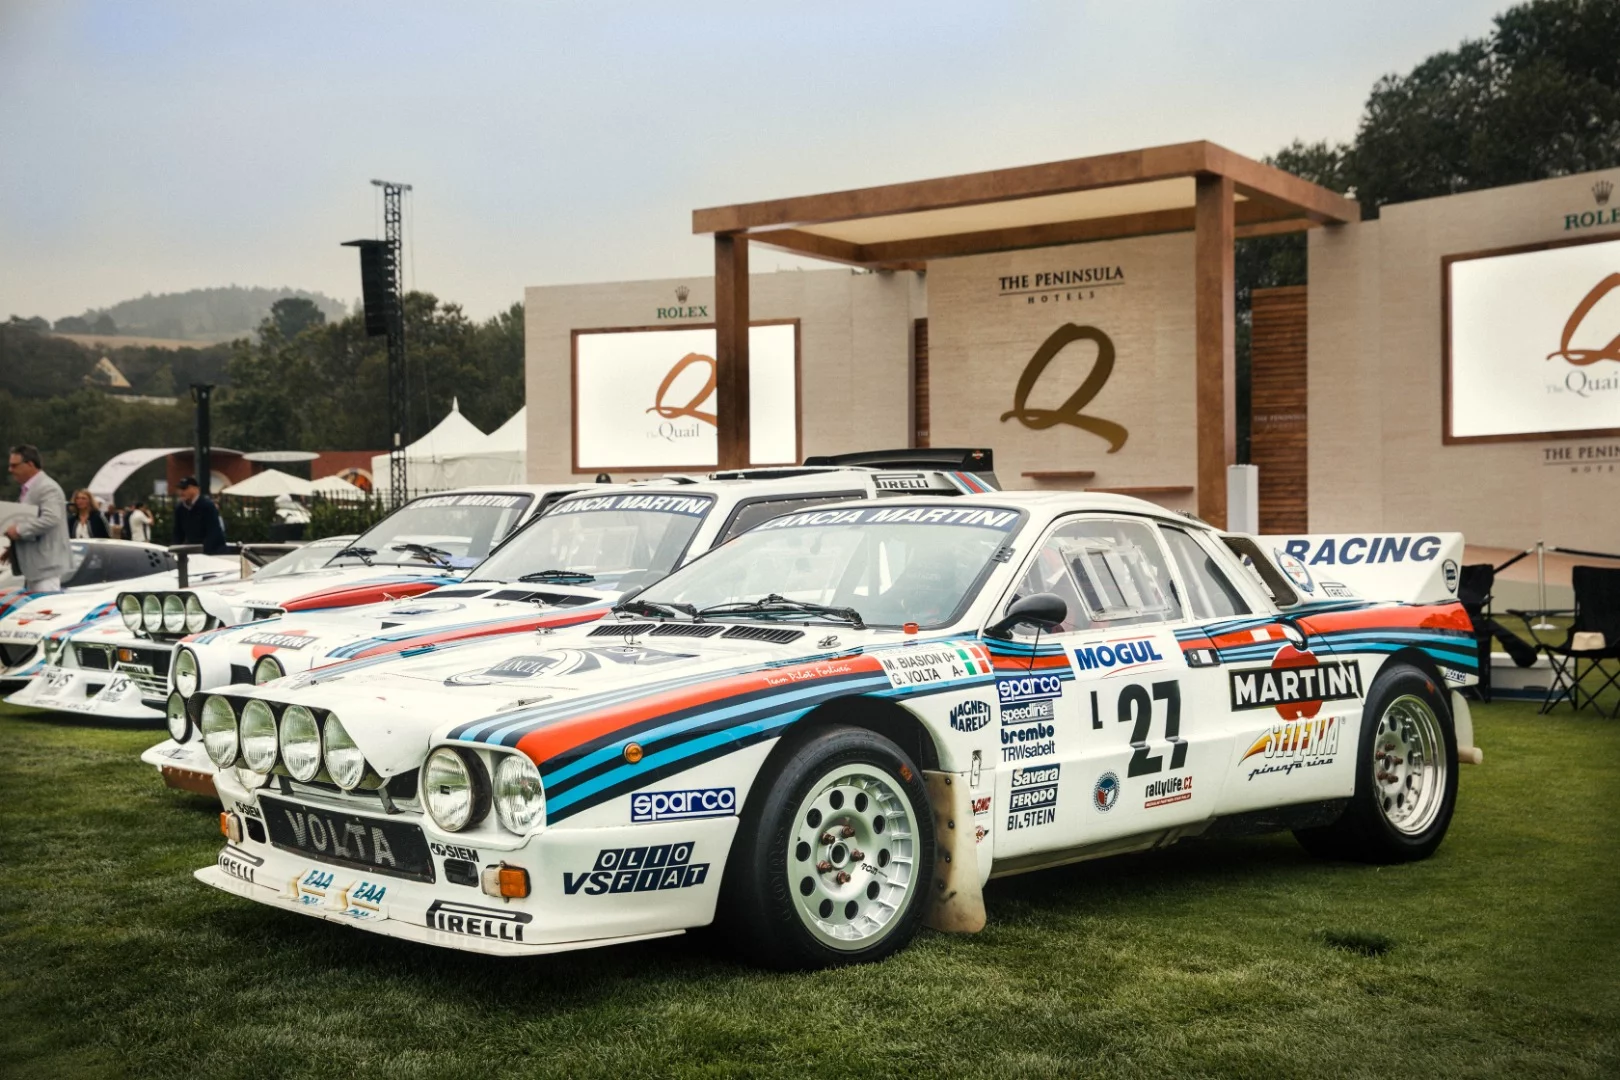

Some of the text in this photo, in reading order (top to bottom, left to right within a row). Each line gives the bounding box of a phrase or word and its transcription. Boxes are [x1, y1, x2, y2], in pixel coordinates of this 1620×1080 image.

[999, 266, 1124, 290] THE PENINSULA
[1027, 291, 1095, 304] HOTELS
[656, 305, 708, 319] ROLEX
[658, 421, 700, 443] Quail
[1544, 447, 1572, 460] THE
[871, 473, 929, 489] PIRELLI
[456, 495, 520, 508] MARTINI
[553, 496, 712, 515] LANCIA MARTINI
[759, 508, 1018, 530] LANCIA MARTINI
[1285, 535, 1442, 566] RACING
[899, 654, 941, 670] BIASION
[1074, 640, 1163, 671] MOGUL
[108, 677, 132, 693] VS
[906, 668, 941, 684] VOLTA
[1234, 665, 1358, 706] MARTINI
[999, 675, 1061, 701] sparco
[950, 700, 991, 719] MAGNETI
[1001, 703, 1048, 722] speedline
[951, 713, 991, 732] MARELLI
[1117, 680, 1189, 779] 27
[1000, 723, 1055, 744] brembo
[1013, 766, 1059, 787] Savara
[1144, 776, 1193, 798] rallylife.cz
[633, 789, 735, 820] sparco
[1011, 787, 1055, 808] FERODO
[1007, 808, 1056, 831] BILSTEIN
[285, 809, 397, 867] VOLTA
[446, 845, 480, 863] SIEM
[601, 845, 689, 869] OLIO
[303, 869, 335, 890] EAA
[617, 866, 704, 890] FIAT
[352, 881, 387, 905] EAA
[426, 899, 533, 942] PIRELLI
